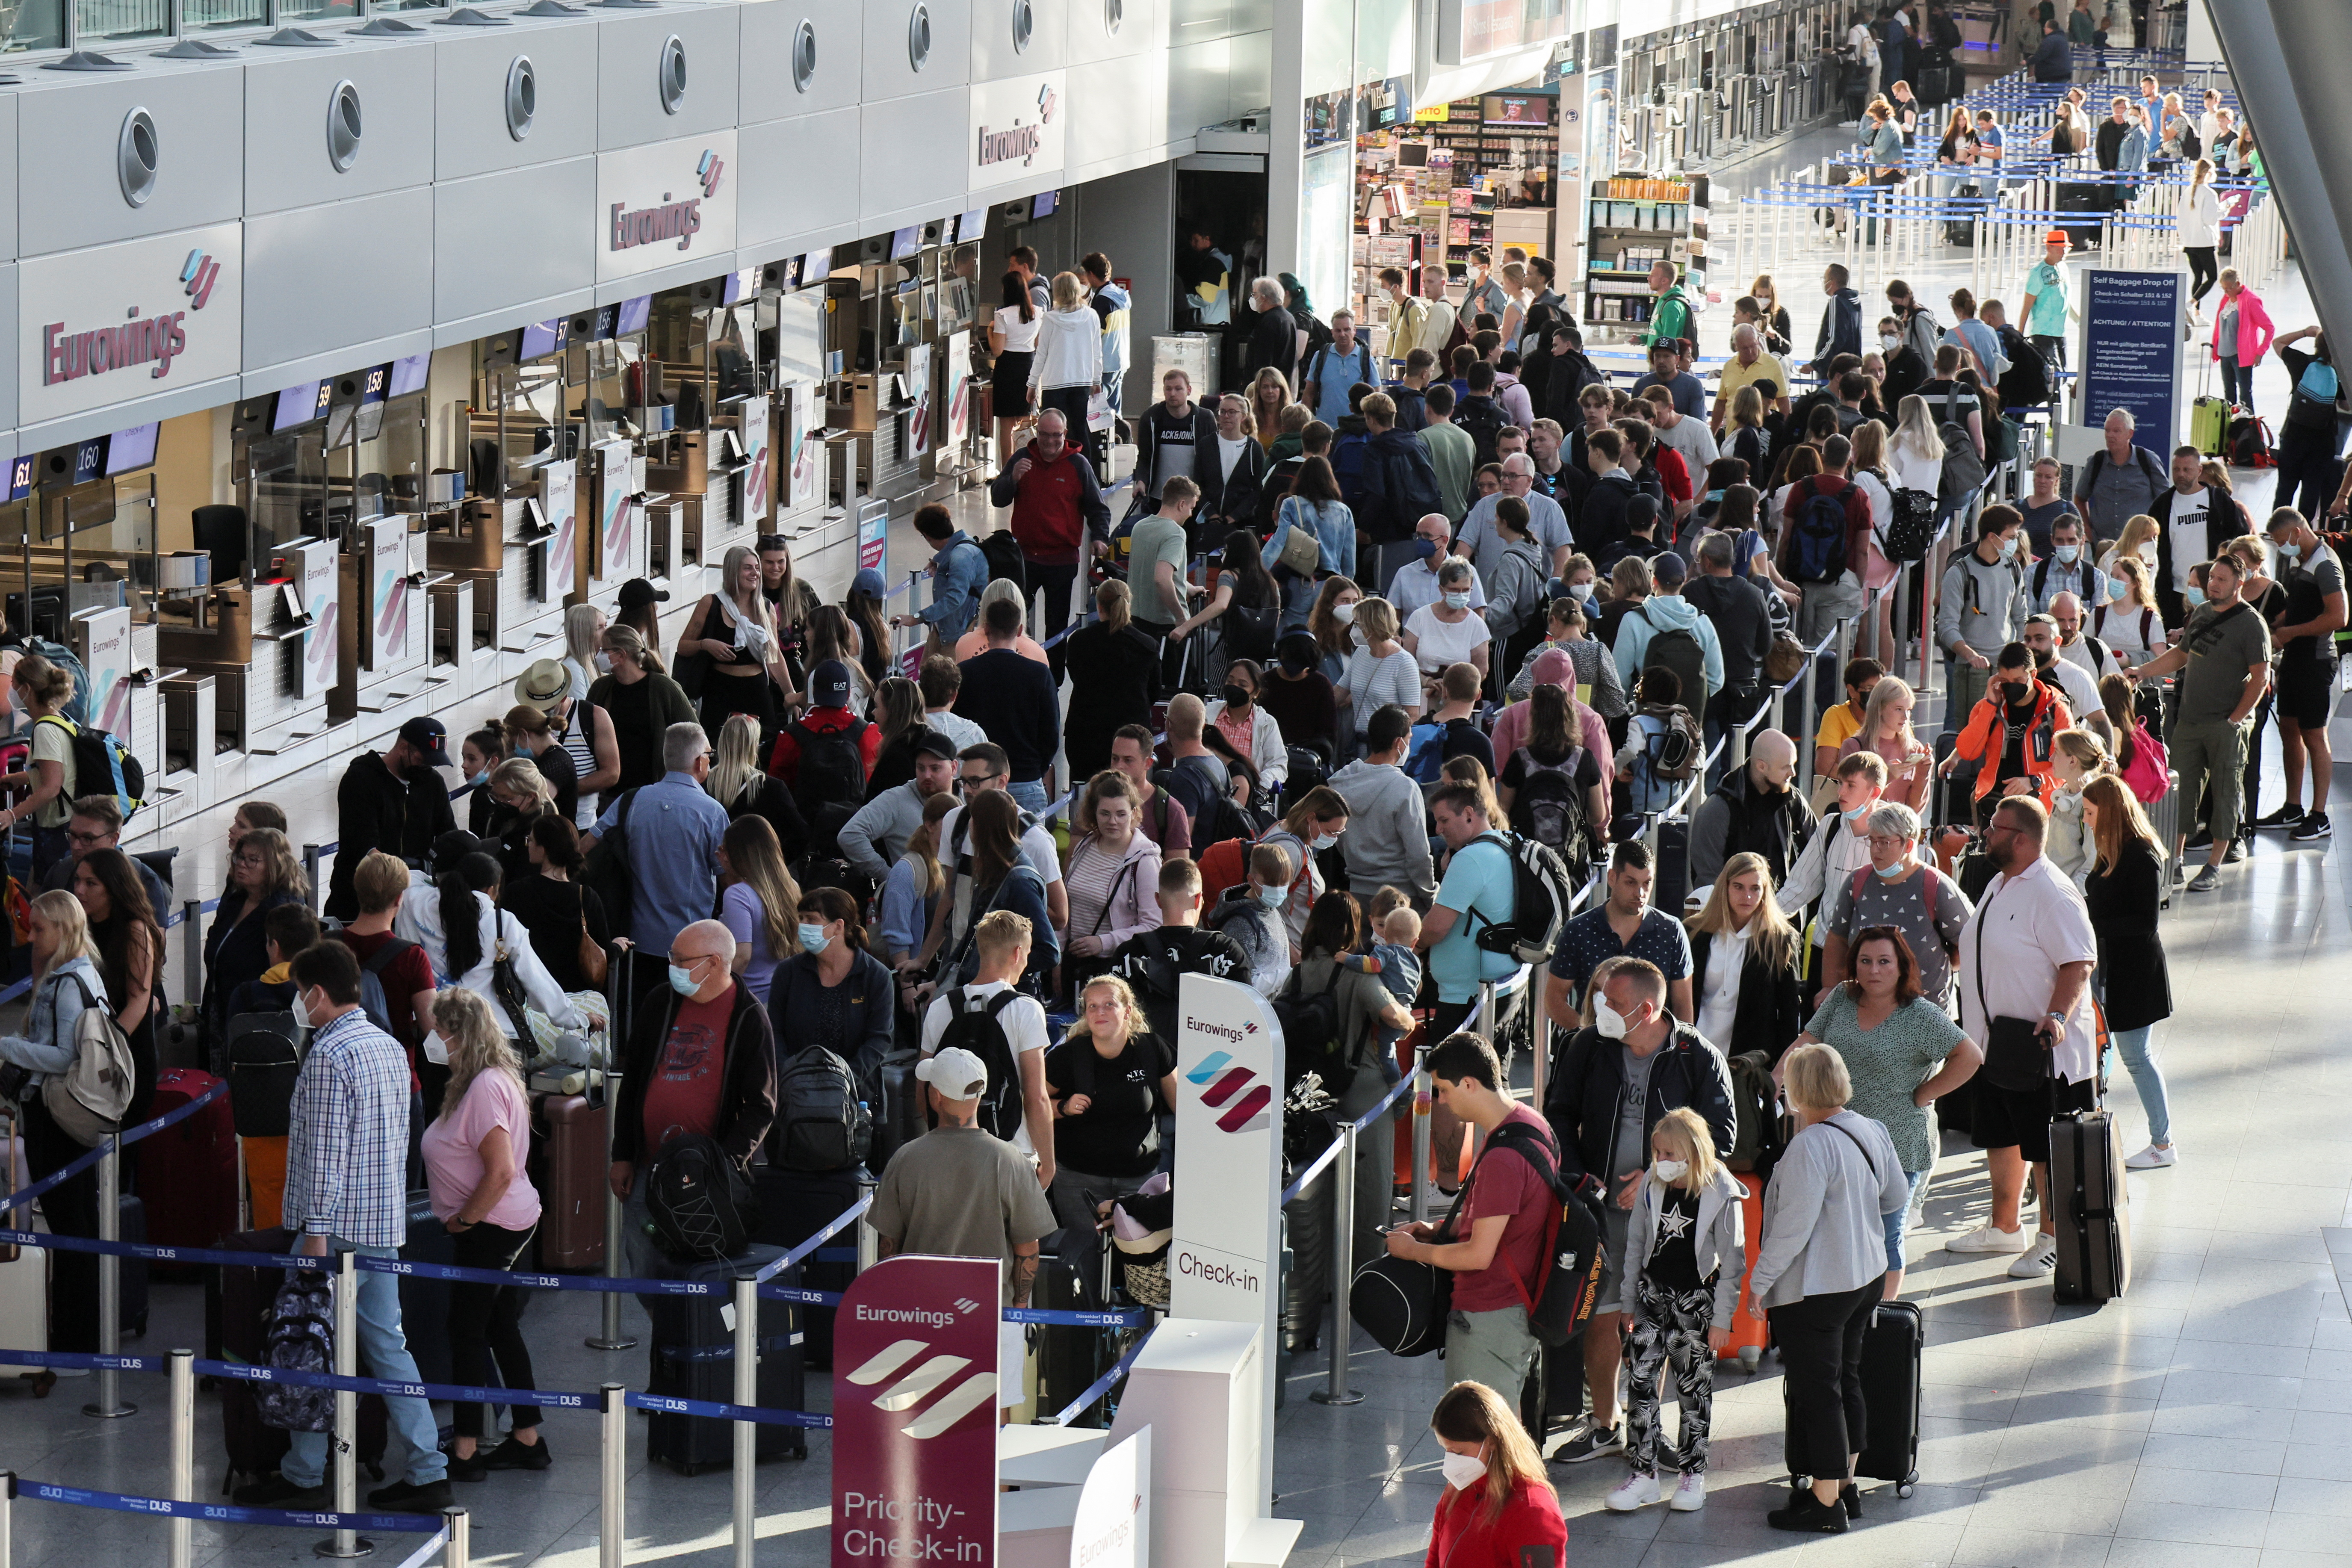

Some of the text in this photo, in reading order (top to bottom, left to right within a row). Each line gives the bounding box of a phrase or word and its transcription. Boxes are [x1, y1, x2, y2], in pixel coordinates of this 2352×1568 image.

[1554, 40, 1574, 63] WHSmith
[1371, 83, 1396, 111] WHSmith
[1380, 108, 1395, 124] EXPRESS
[979, 118, 1040, 167] Eurowings
[612, 192, 700, 251] Eurowings
[944, 219, 954, 236] 152
[786, 260, 798, 279] 154
[2109, 278, 2141, 286] Baggage
[597, 311, 612, 331] 156
[44, 306, 186, 386] Eurowings
[366, 370, 384, 393] 158
[748, 417, 762, 428] Eurowings
[78, 445, 99, 471] 160
[13, 462, 30, 488] 61
[607, 464, 624, 476] Eurowings
[550, 483, 568, 496] Eurowings
[2178, 512, 2207, 526] PUMA
[378, 542, 399, 556] Eurowings
[308, 566, 329, 580] Eurowings
[93, 638, 119, 653] Eurowings
[1187, 1016, 1243, 1043] Eurowings
[2, 1199, 10, 1210] DUS
[18, 1233, 35, 1243] DUS
[157, 1248, 175, 1258] DUS
[298, 1258, 316, 1267] DUS
[393, 1263, 411, 1273] DUS
[1179, 1252, 1258, 1292] Check-in
[540, 1277, 559, 1287] DUS
[688, 1284, 707, 1293] DUS
[802, 1291, 821, 1302] DUS
[1577, 1281, 1599, 1320] IOWA
[857, 1304, 954, 1329] Eurowings
[1103, 1315, 1123, 1324] DUS
[121, 1358, 142, 1368] DUS
[251, 1369, 271, 1379] DUS
[405, 1385, 425, 1395] DUS
[560, 1395, 581, 1405] DUS
[666, 1399, 687, 1410] DUS
[150, 1500, 171, 1512] DUS
[845, 1492, 965, 1530] Priority-
[316, 1514, 338, 1524] DUS
[433, 1533, 442, 1549] DUS
[843, 1530, 982, 1562] Check-in
[1080, 1520, 1129, 1568] Eurowings
